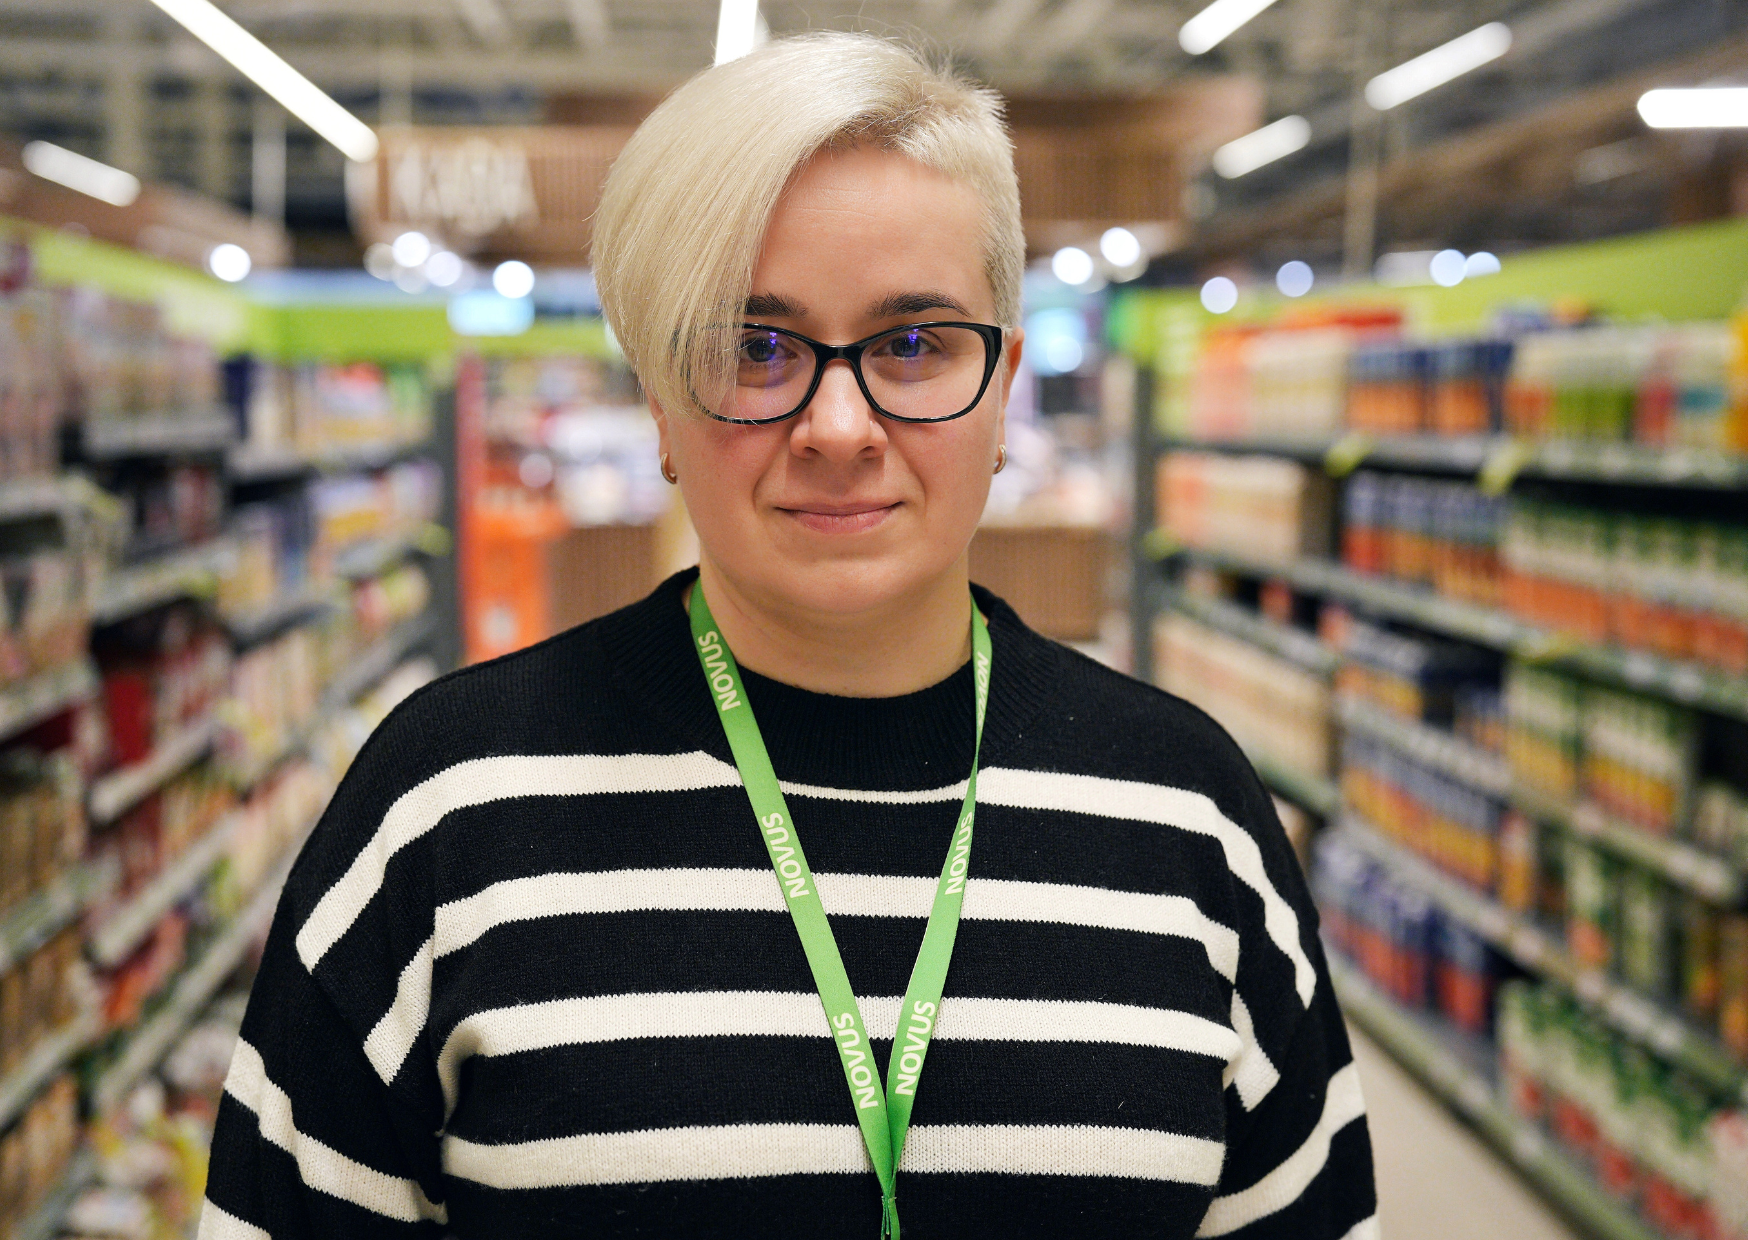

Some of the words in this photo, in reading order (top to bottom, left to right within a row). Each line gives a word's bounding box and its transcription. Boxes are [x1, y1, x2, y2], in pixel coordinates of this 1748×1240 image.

[698, 631, 741, 711] NOVUS
[762, 812, 810, 898] NOVUS
[945, 811, 973, 895] NOVUS
[833, 1012, 879, 1109] NOVUS
[895, 1000, 936, 1096] NOVUS
